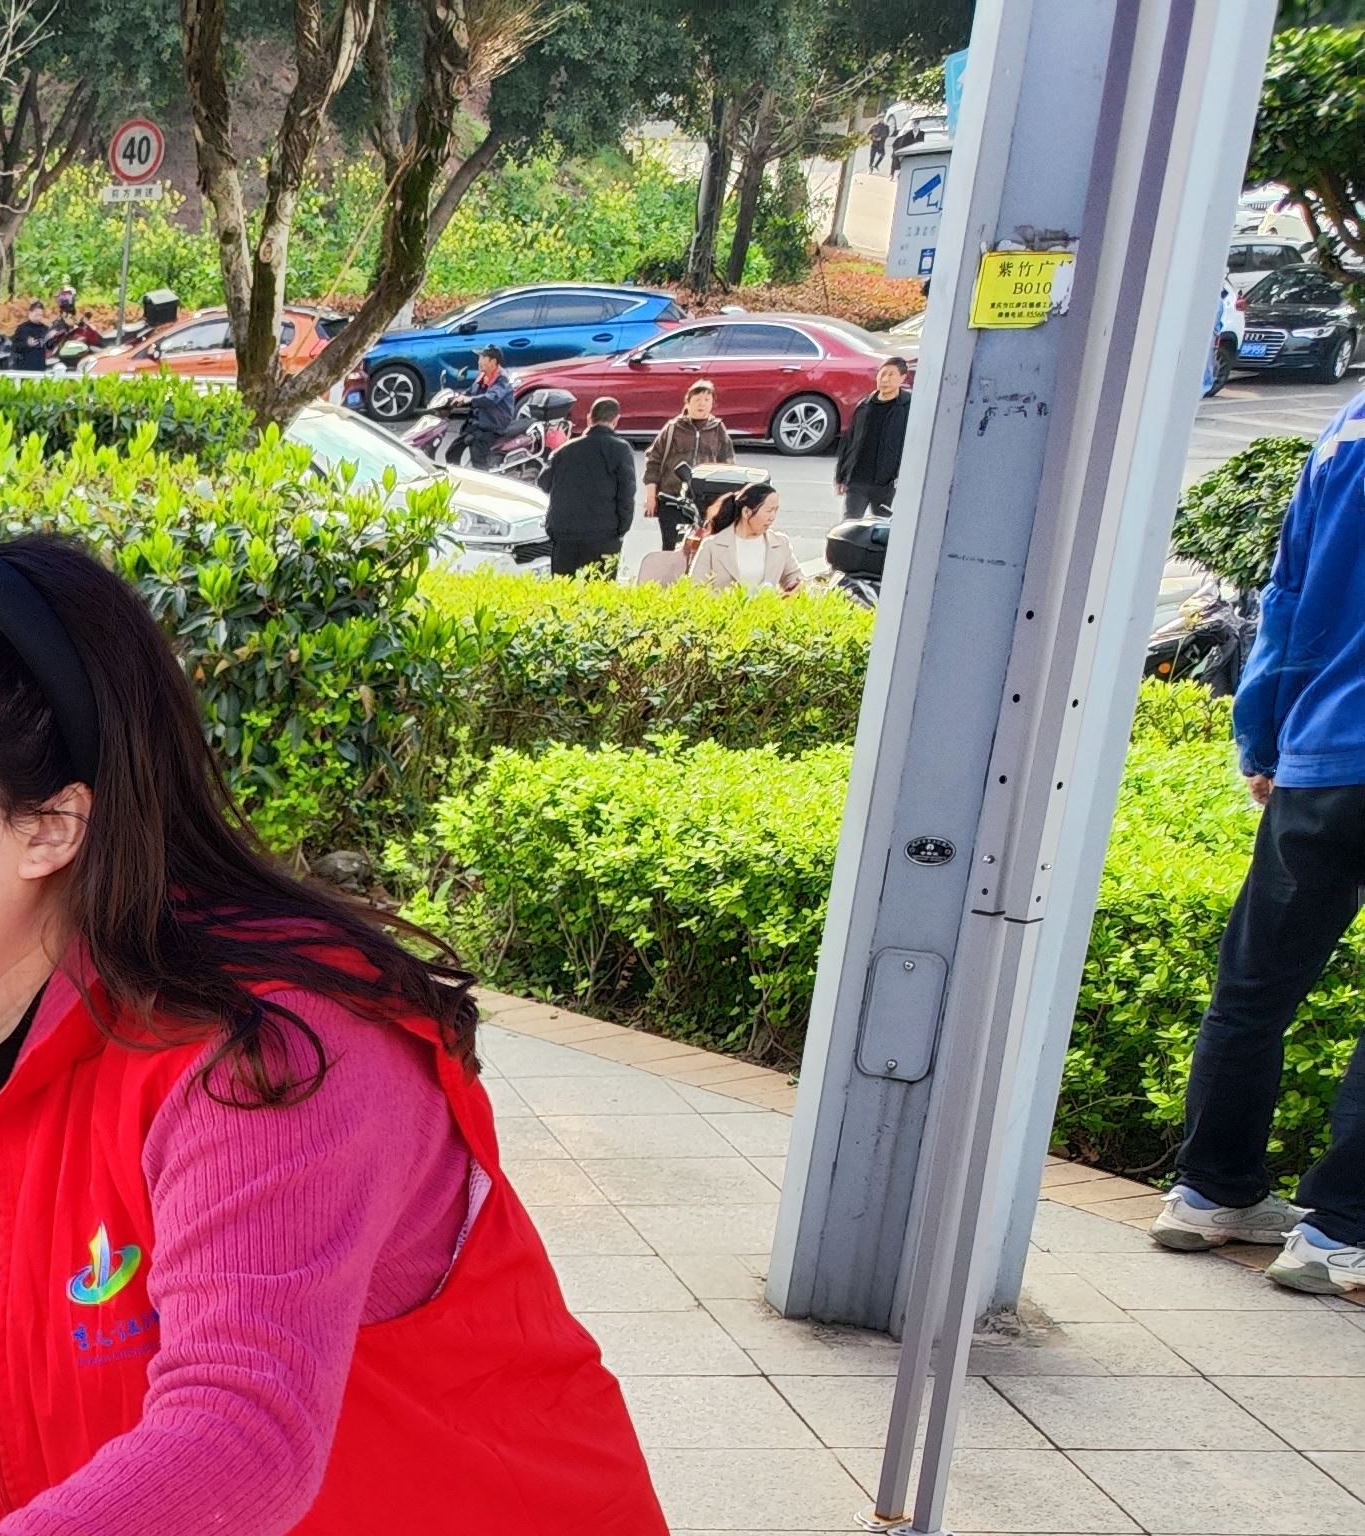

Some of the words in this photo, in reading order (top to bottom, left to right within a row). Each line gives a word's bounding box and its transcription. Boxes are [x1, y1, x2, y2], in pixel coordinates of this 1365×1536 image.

[122, 136, 151, 165] 40
[998, 260, 1073, 277] 紫竹广
